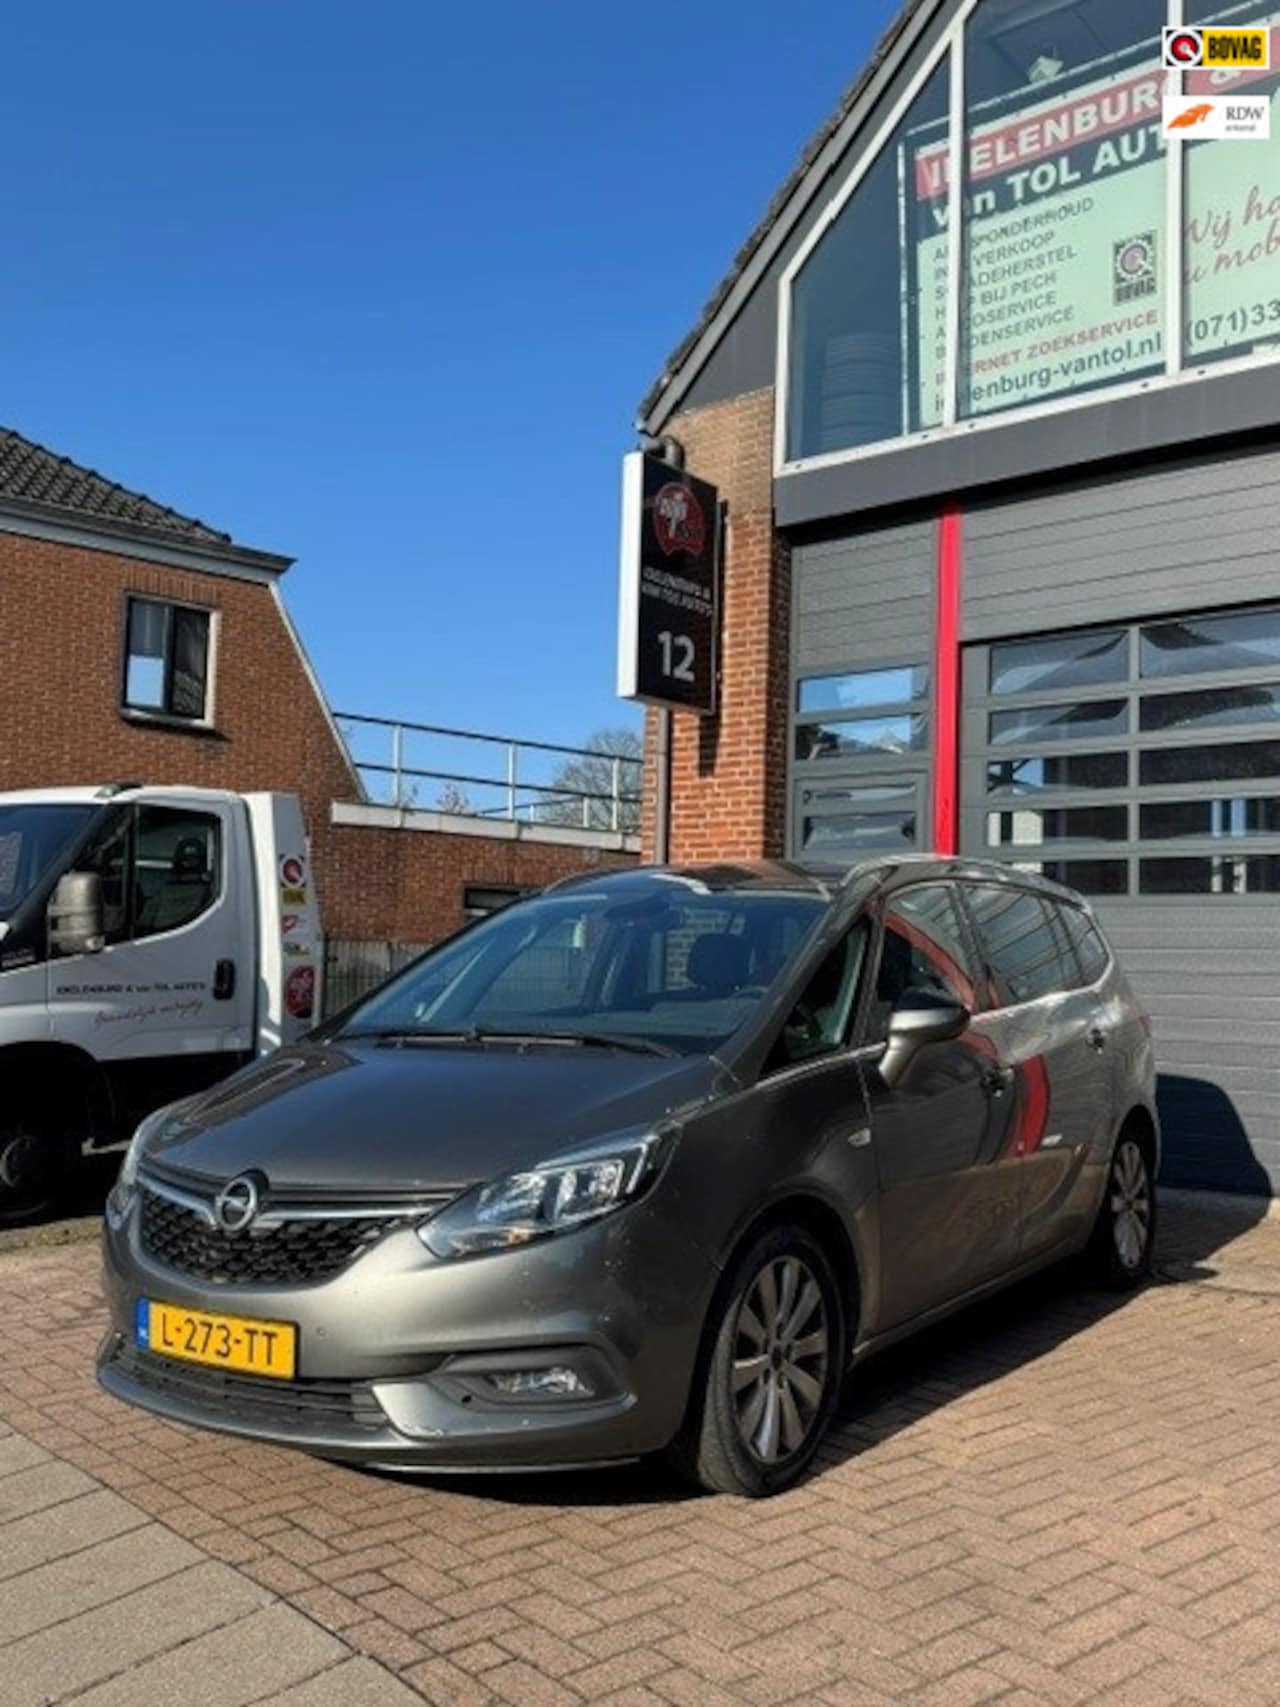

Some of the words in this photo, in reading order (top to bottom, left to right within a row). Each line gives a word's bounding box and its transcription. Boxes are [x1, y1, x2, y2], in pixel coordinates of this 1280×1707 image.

[933, 190, 996, 228] vn
[1005, 157, 1081, 200] TOL
[1011, 271, 1057, 296] PECH
[1026, 310, 1158, 359] ZOEKSERVICE
[657, 630, 696, 683] 12
[162, 1312, 278, 1367] L-273-TT
